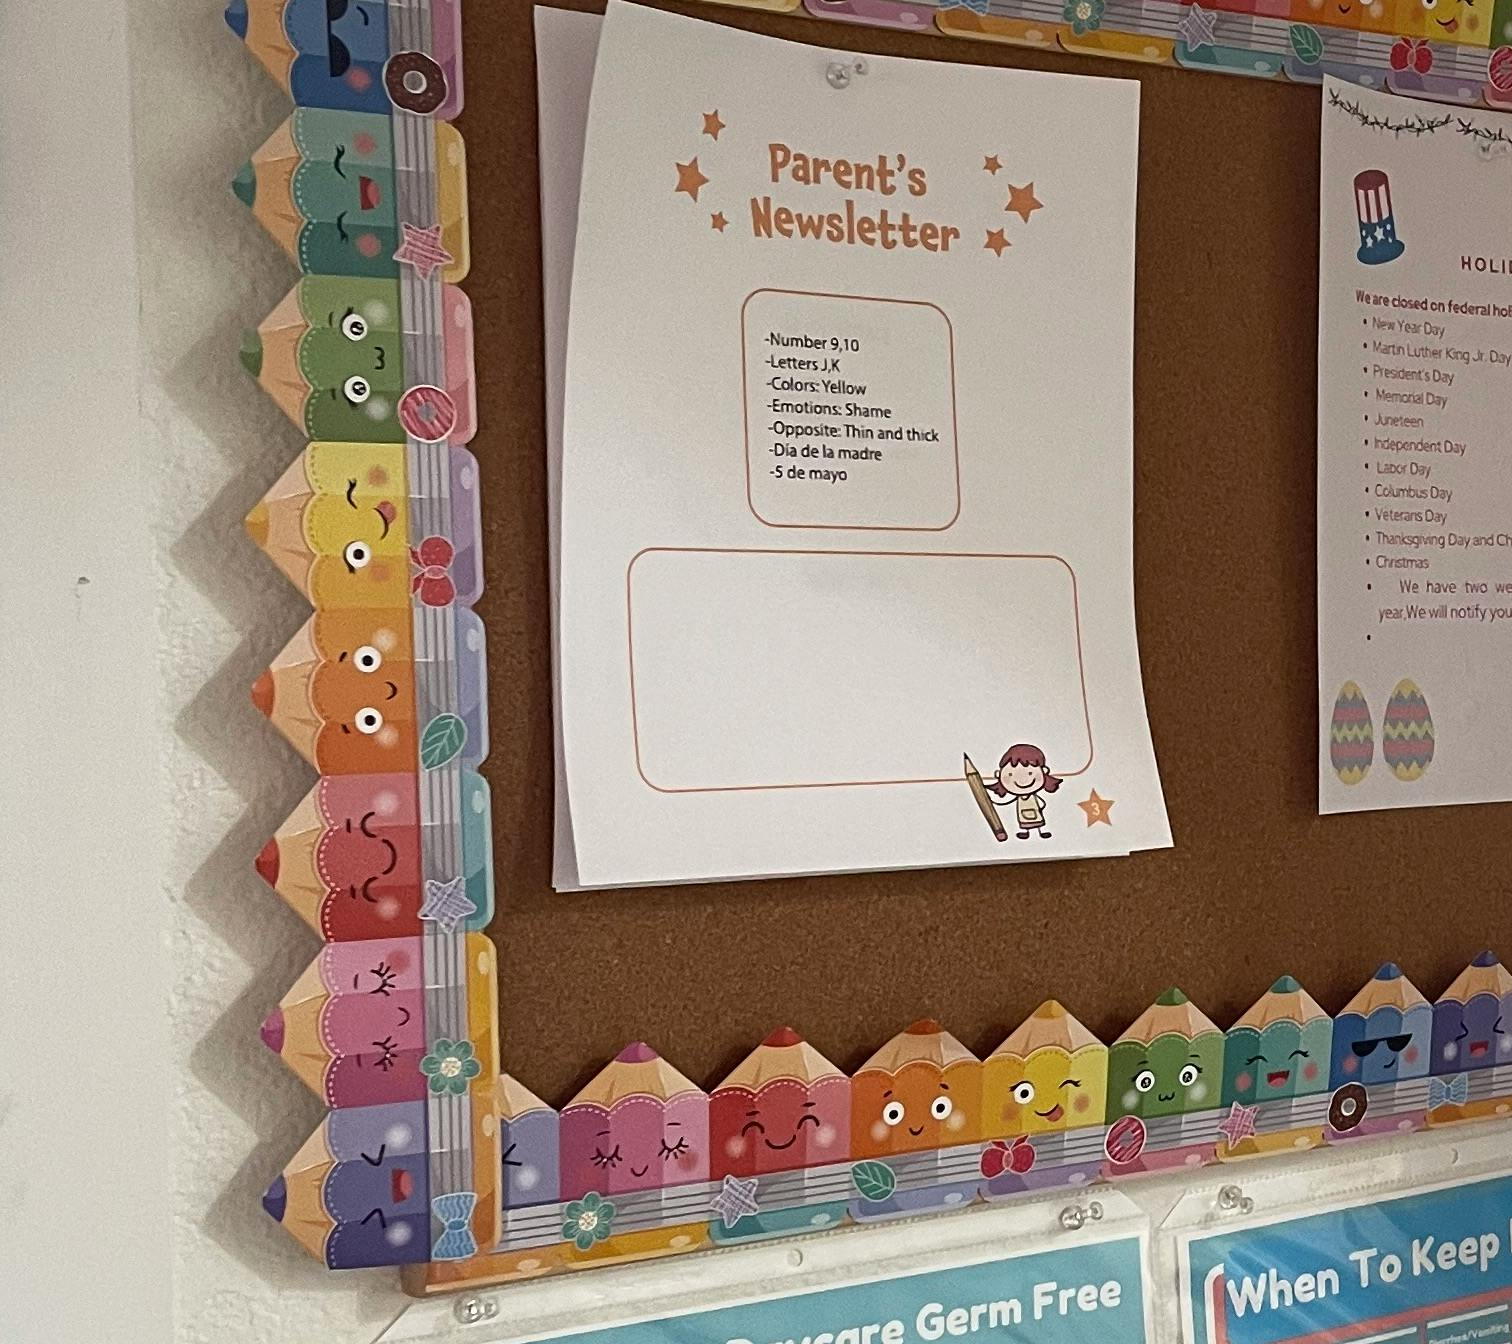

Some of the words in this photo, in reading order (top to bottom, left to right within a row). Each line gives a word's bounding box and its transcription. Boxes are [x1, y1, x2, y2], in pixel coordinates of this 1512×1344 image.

[769, 144, 927, 196] Parent's
[751, 197, 960, 252] Newsletter
[1392, 295, 1427, 310] closed
[1448, 301, 1490, 316] federal
[831, 337, 859, 352] 9,10
[1407, 343, 1442, 359] Luther
[823, 380, 866, 395] Yellow
[1427, 392, 1448, 408] Day
[846, 403, 891, 418] Shame
[844, 424, 873, 439] Thin
[878, 428, 902, 440] and
[907, 429, 939, 441] thick
[801, 444, 819, 458] de
[838, 447, 882, 461] madre
[1444, 440, 1466, 456] Day
[787, 466, 805, 479] de
[809, 468, 847, 484] mayo
[1375, 484, 1428, 499] Columbus
[1431, 486, 1452, 503] Day
[1375, 509, 1422, 522] Veterans
[1376, 532, 1445, 548] Thanksgiving
[1450, 606, 1487, 621] notify
[1227, 1266, 1339, 1318] When
[1349, 1248, 1401, 1289] To
[1412, 1233, 1499, 1276] Keep
[916, 1298, 1022, 1341] Germ
[1033, 1280, 1121, 1320] Free
